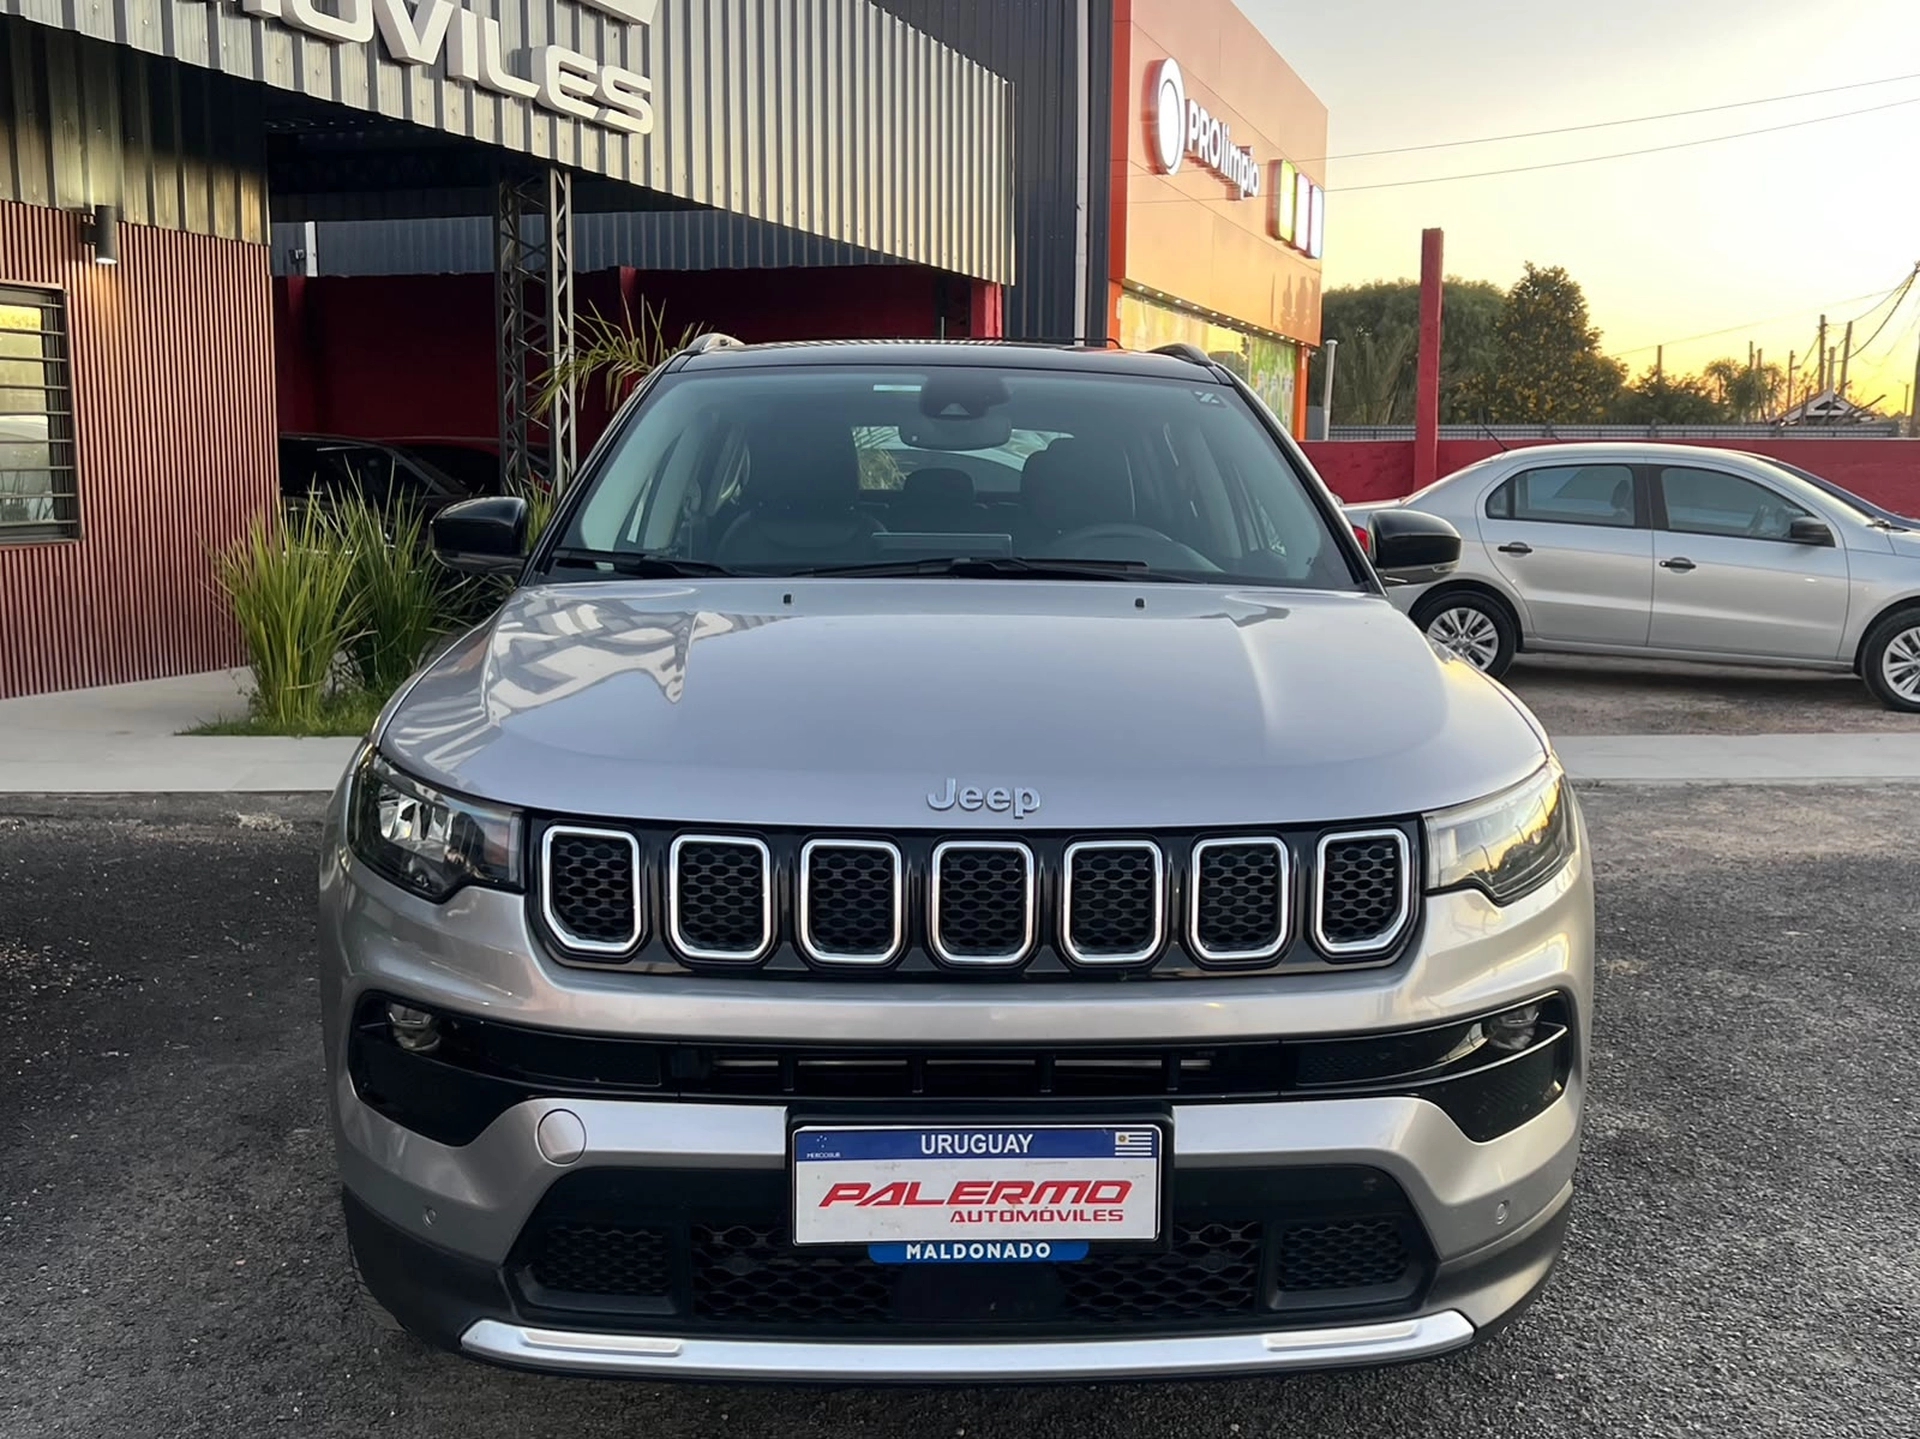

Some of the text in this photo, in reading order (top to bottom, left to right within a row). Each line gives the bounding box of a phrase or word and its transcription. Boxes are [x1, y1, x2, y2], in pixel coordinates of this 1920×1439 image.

[242, 0, 653, 135] VILES
[927, 777, 1041, 819] Jeep
[920, 1133, 1034, 1155] URUGUAY
[818, 1180, 1133, 1208] PALERMO
[950, 1206, 1124, 1224] AUTOMÓVILES
[905, 1242, 1052, 1260] MALDONADO
